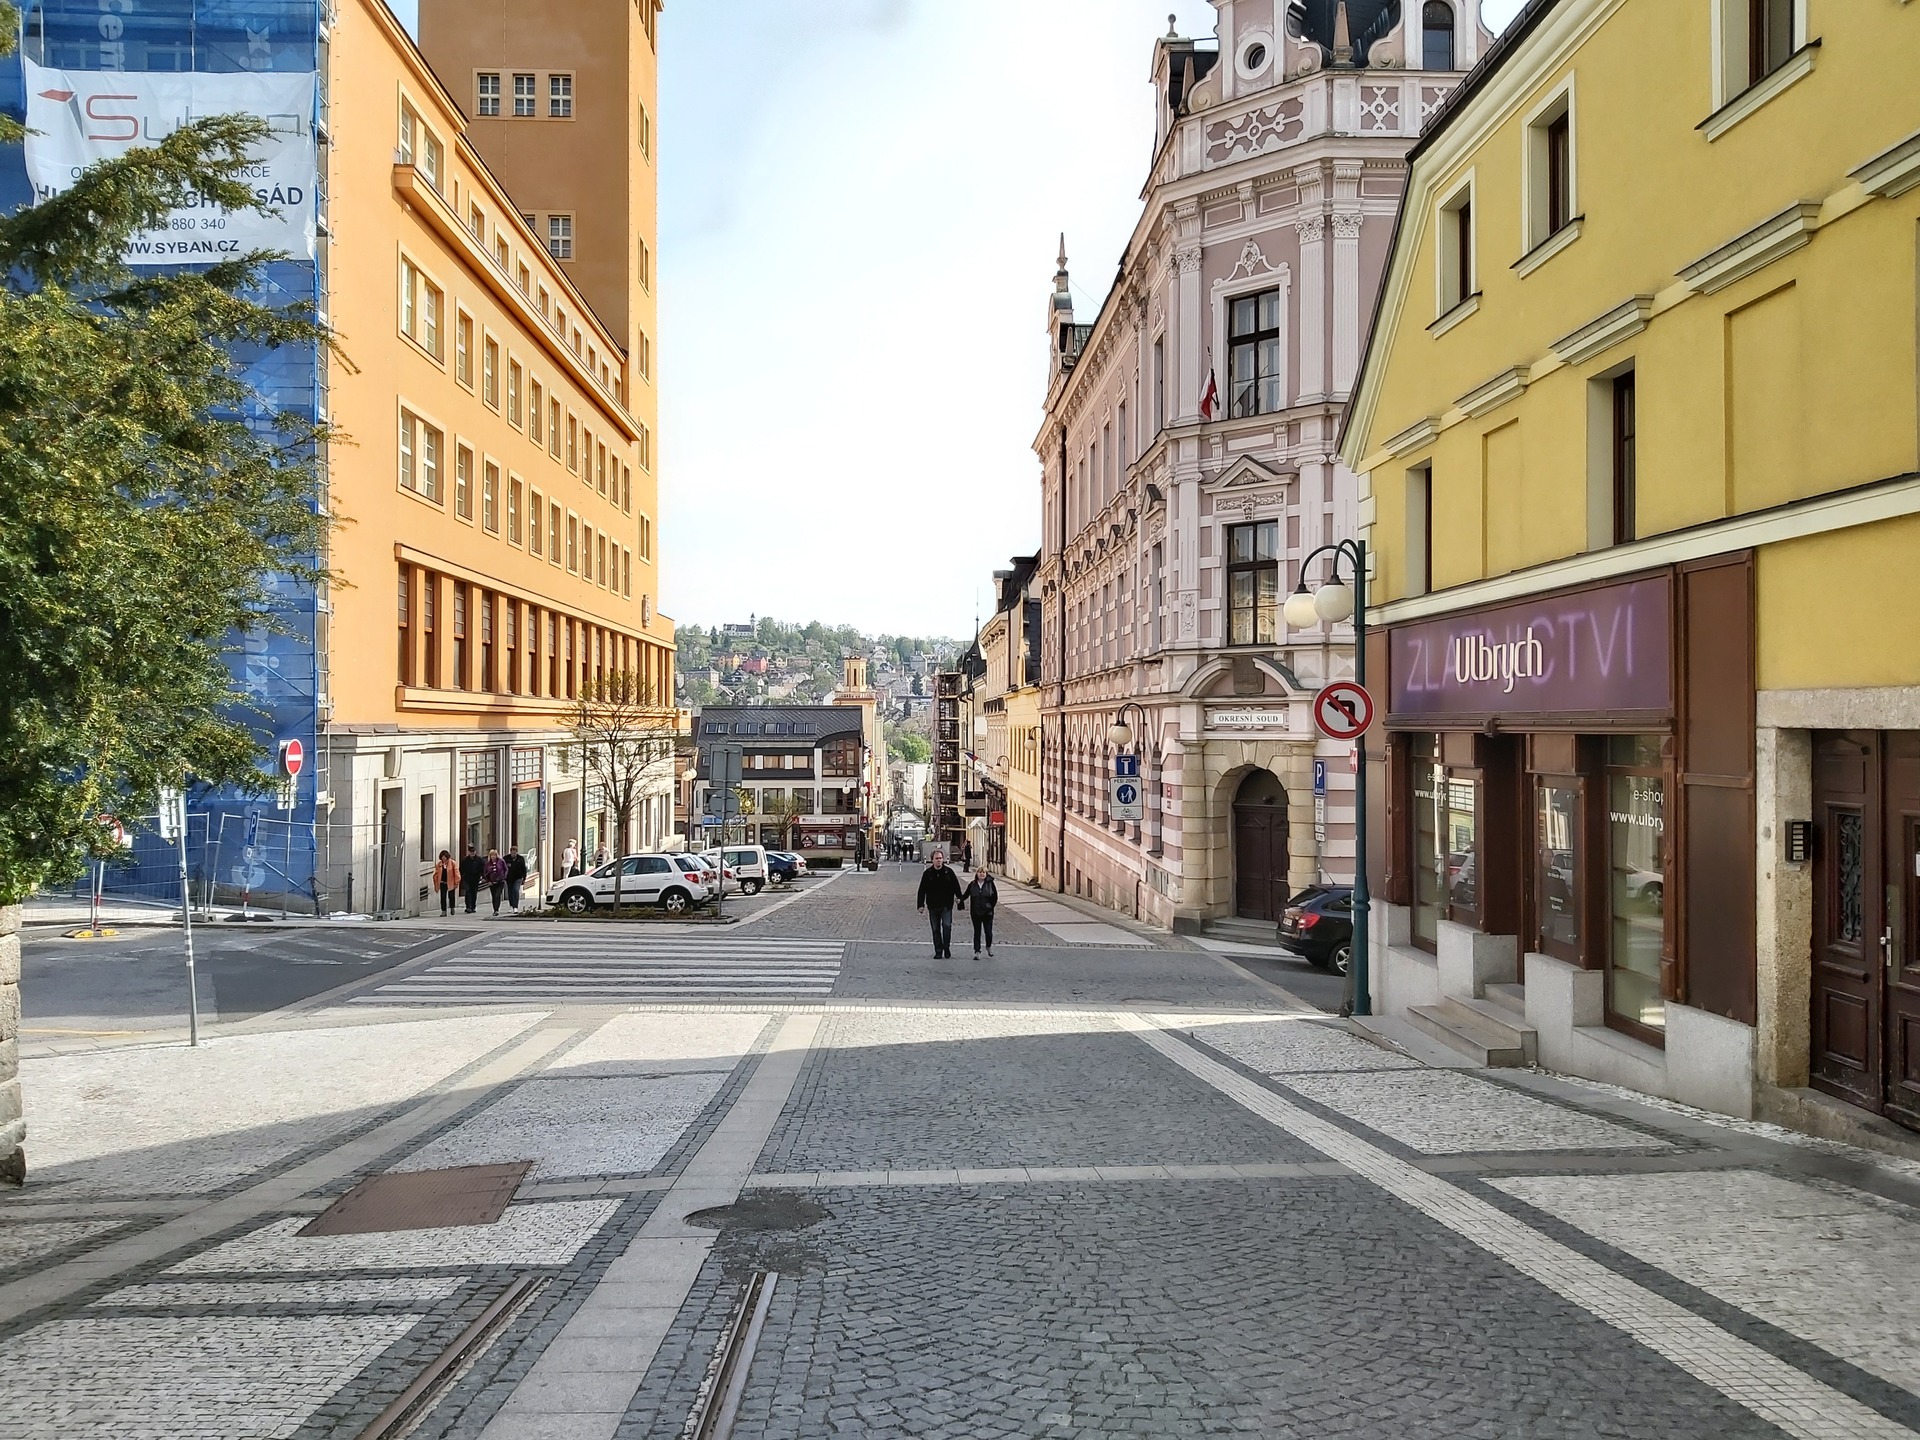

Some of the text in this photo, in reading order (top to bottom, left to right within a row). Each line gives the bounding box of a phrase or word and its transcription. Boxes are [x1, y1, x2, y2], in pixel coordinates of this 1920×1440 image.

[171, 218, 196, 230] 880
[200, 217, 226, 230] 340
[1455, 626, 1543, 694] Ulbrych
[1256, 715, 1279, 723] SOUD
